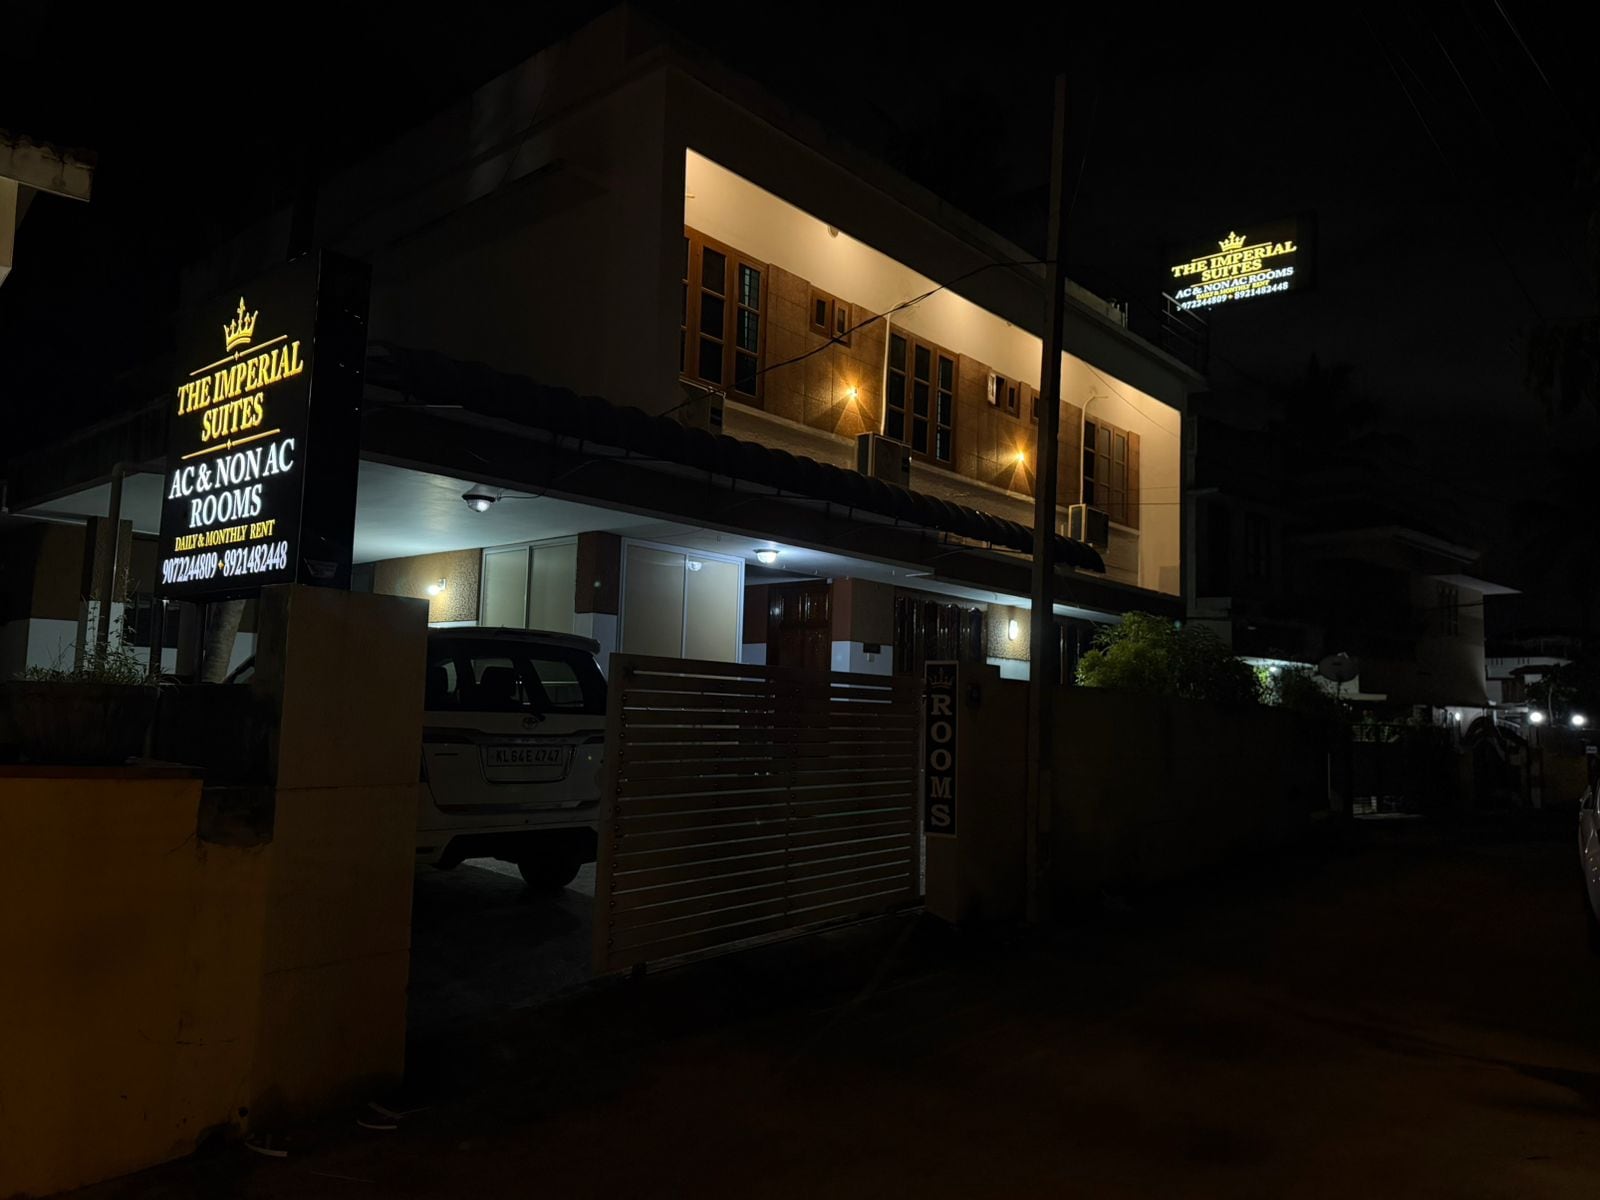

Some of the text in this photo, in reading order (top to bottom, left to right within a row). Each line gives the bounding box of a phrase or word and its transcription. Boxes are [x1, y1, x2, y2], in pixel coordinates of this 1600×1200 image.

[1171, 241, 1297, 278] THE IMPERIAL
[1201, 259, 1262, 282] SUITES
[1175, 266, 1294, 299] AC & NON AC ROOMS
[177, 340, 304, 416] THE IMPERIAL
[201, 392, 264, 442] SUITES
[168, 438, 295, 499] AC & NON AC
[189, 483, 263, 528] ROOMS
[249, 519, 276, 539] RENT
[162, 552, 218, 584] 9072244809
[223, 540, 288, 577] 8921482448
[930, 693, 953, 827] ROOMS
